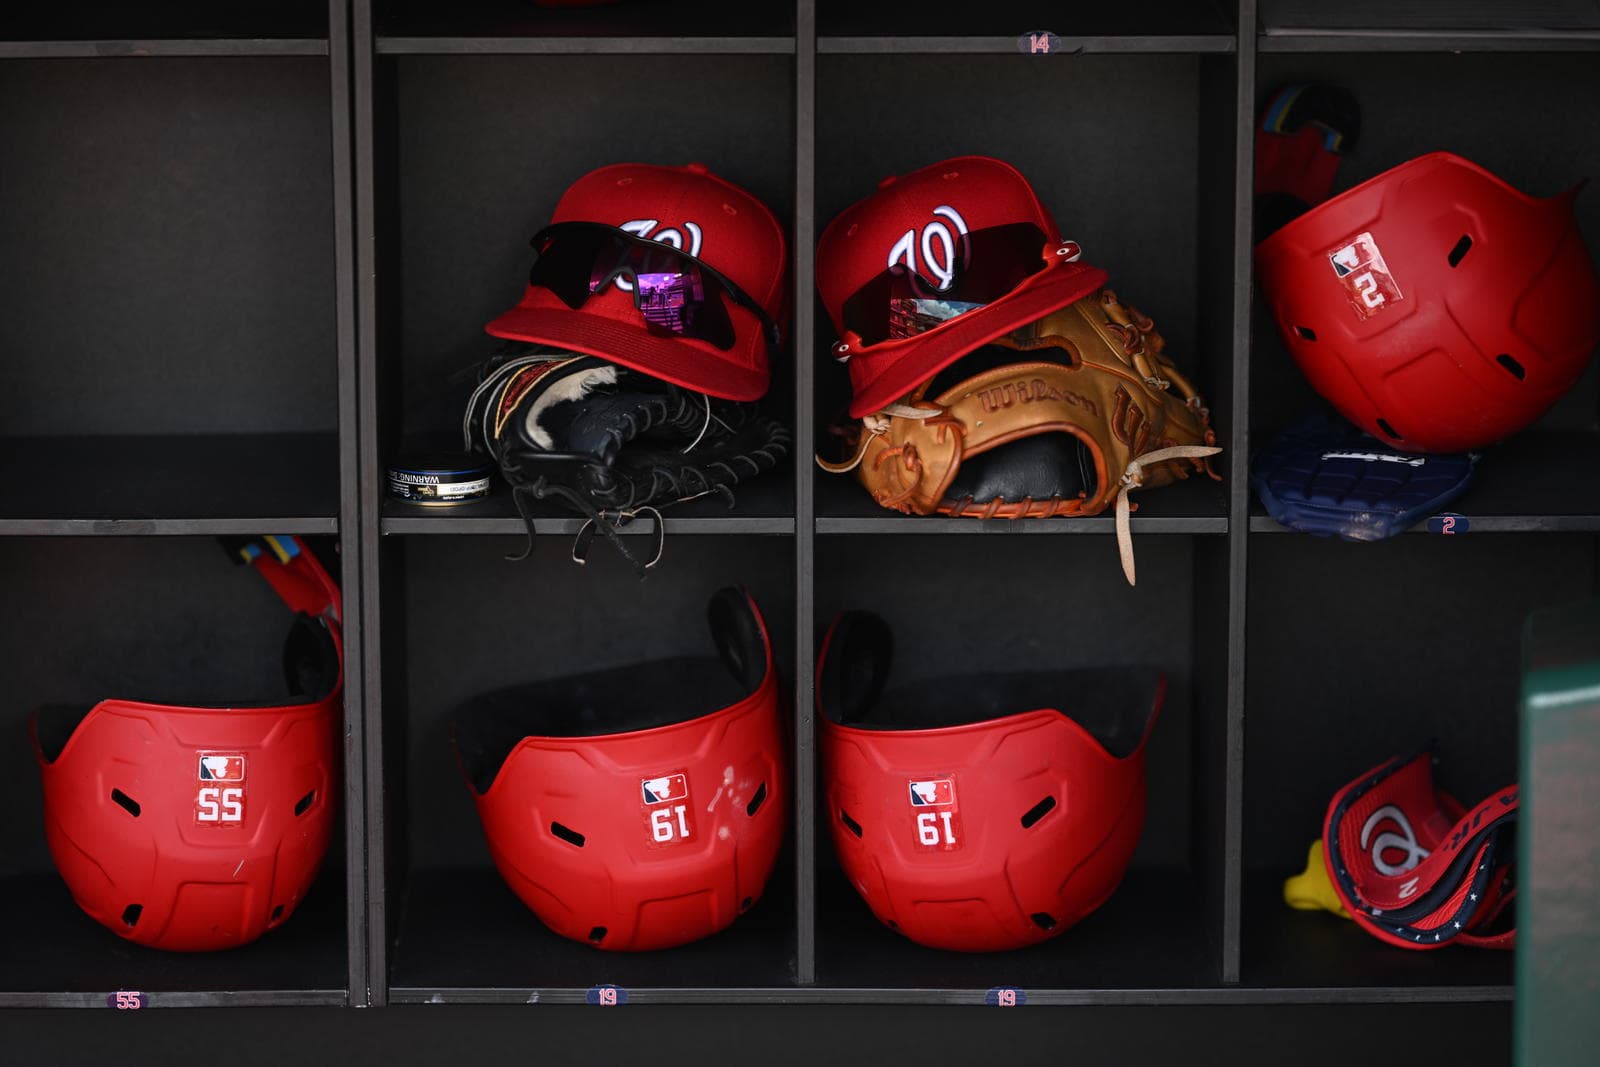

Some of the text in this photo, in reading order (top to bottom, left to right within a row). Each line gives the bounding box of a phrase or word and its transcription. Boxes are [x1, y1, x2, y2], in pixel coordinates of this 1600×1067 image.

[1030, 33, 1049, 54] 14
[1352, 271, 1385, 309] 2
[977, 379, 1099, 418] Wilson
[1442, 517, 1455, 535] 2
[197, 787, 242, 822] 55
[650, 804, 691, 843] 19
[917, 811, 957, 846] 19
[116, 991, 140, 1010] 55
[599, 988, 617, 1006] 19
[998, 989, 1016, 1007] 19
